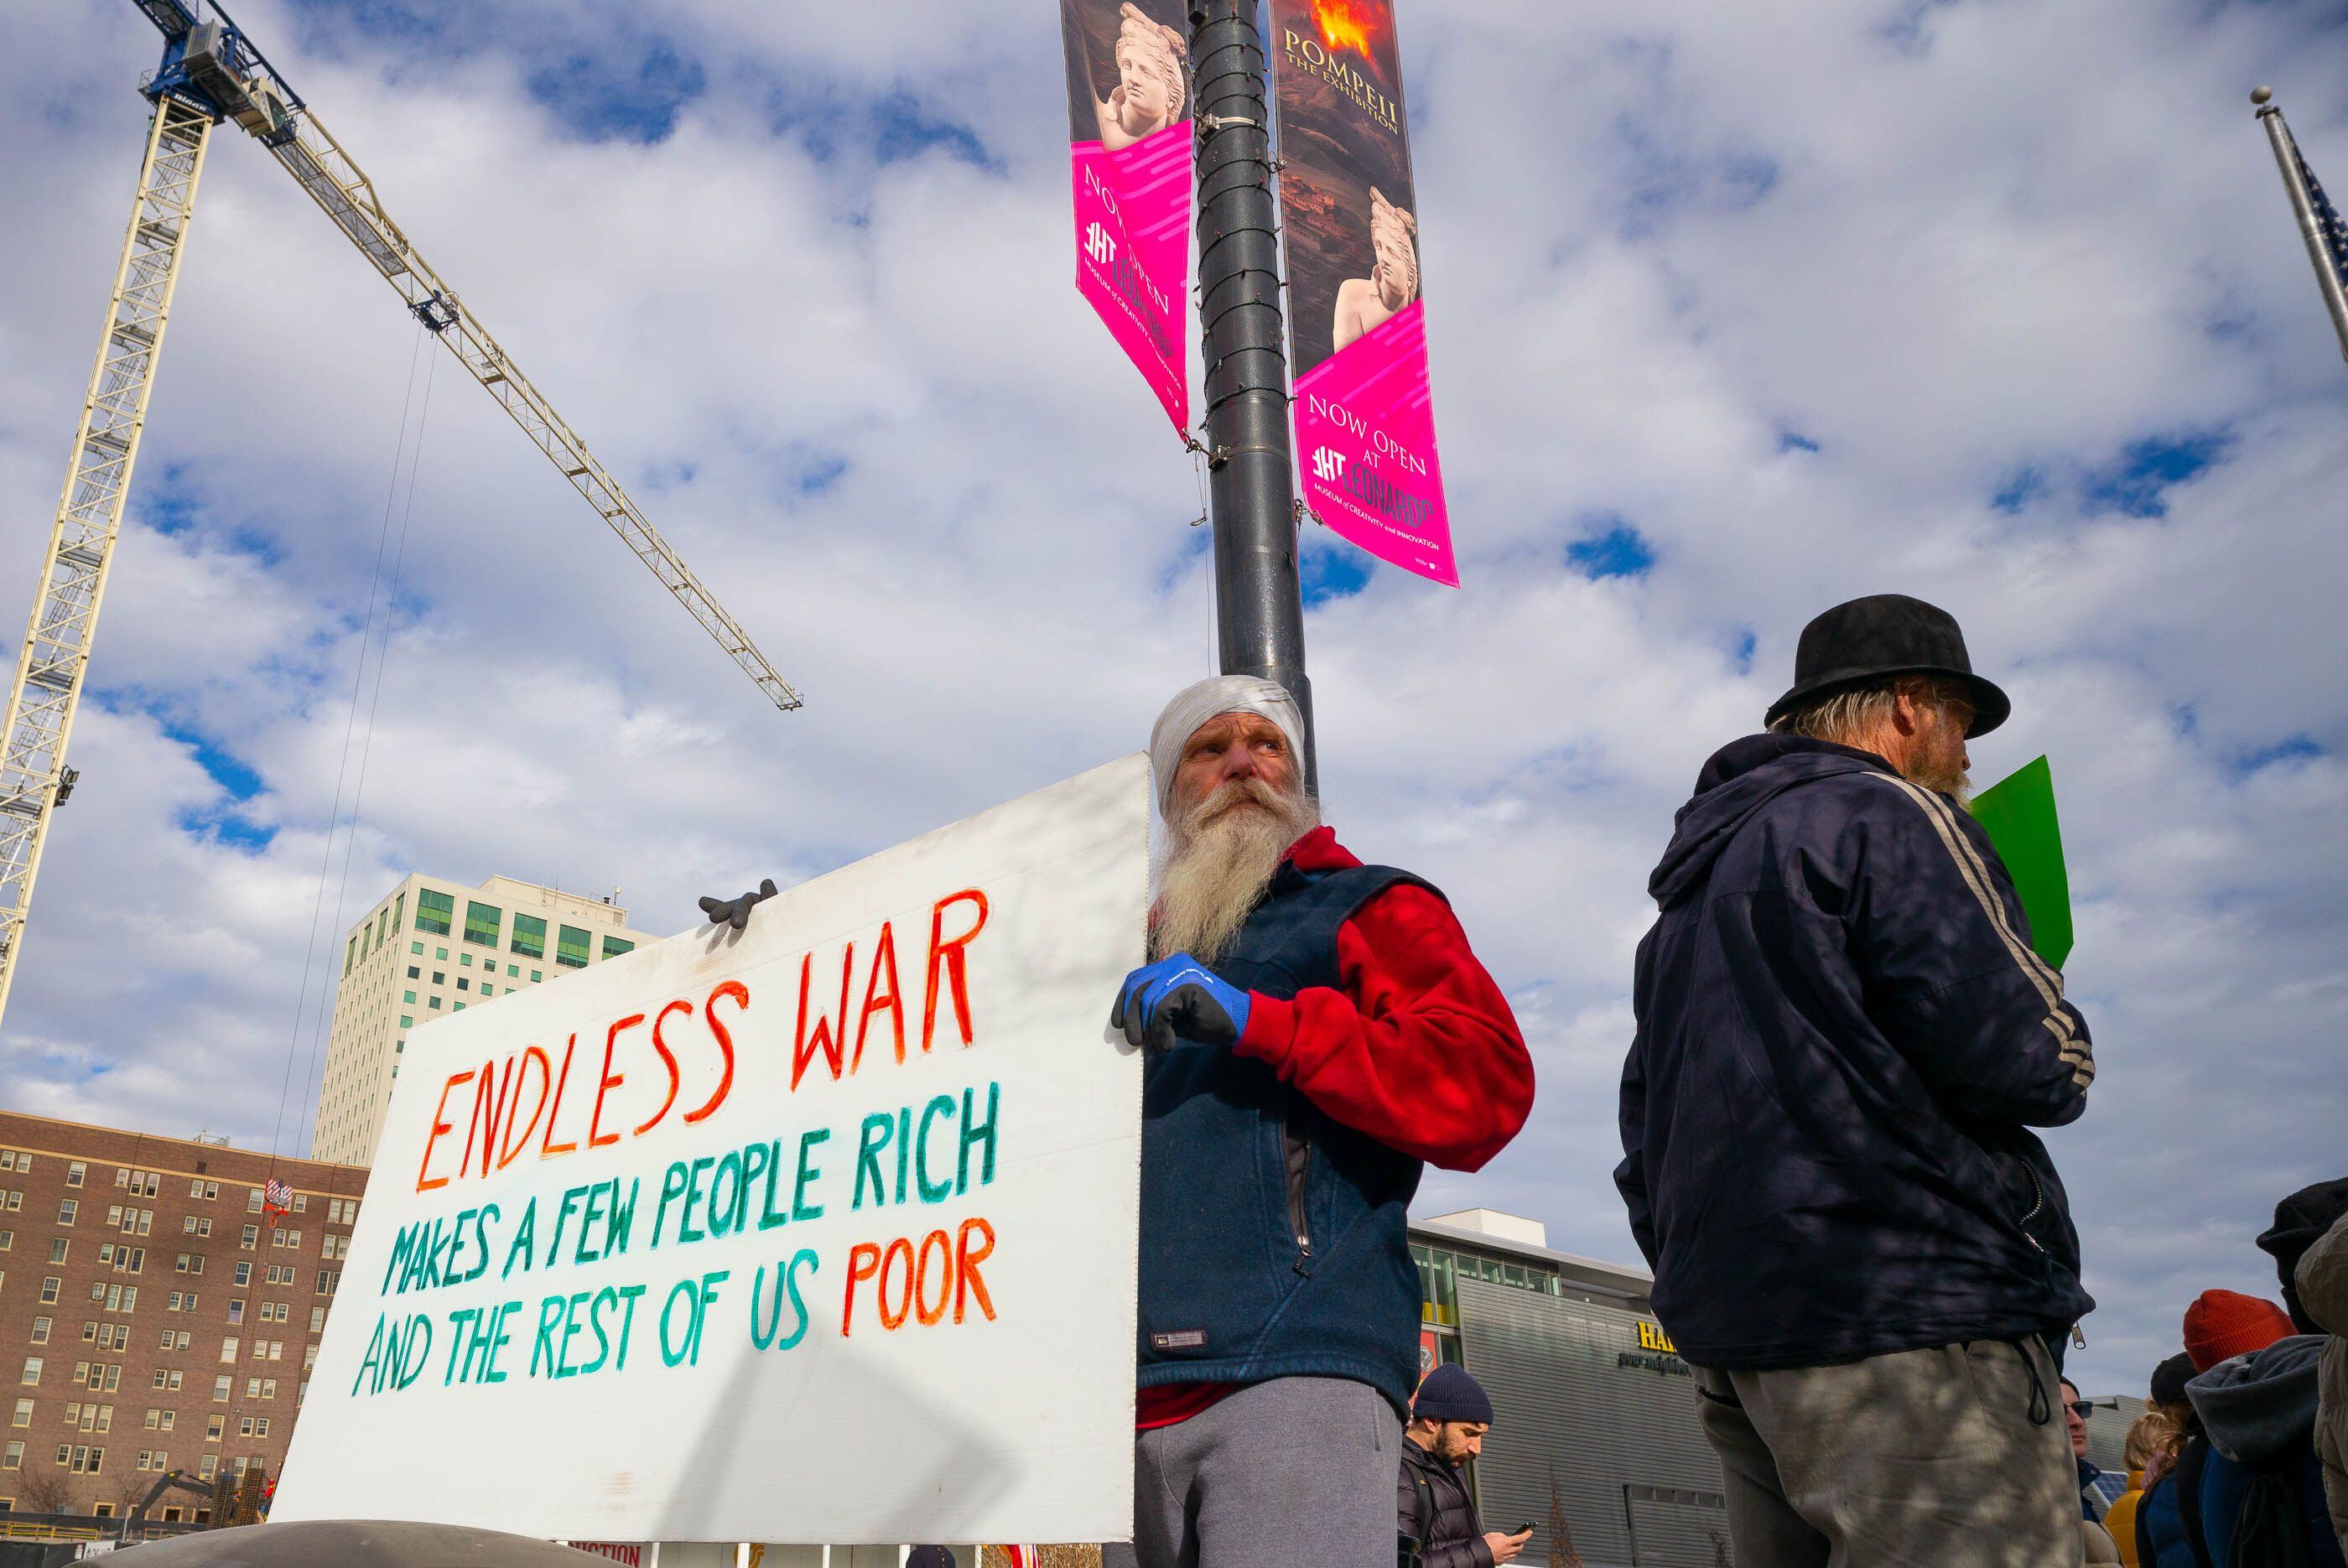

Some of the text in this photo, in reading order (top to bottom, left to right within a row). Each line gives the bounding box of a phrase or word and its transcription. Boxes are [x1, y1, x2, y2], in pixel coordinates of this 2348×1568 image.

[1283, 27, 1398, 125] POMPEII
[1286, 51, 1398, 134] THE EXHIBITION
[1309, 393, 1426, 476] NOW OPEN
[1363, 449, 1380, 468] AT
[1314, 482, 1342, 504] MUSEUM
[1349, 504, 1384, 528] CREATIVITY
[1384, 525, 1395, 534] and
[1396, 530, 1440, 551] INNOVATION
[415, 887, 990, 1194] ENDLESS WAR
[381, 1081, 1000, 1296] MAKES A FEW PEOPLE RICH
[352, 1217, 997, 1397] AND THE REST OF US POOR
